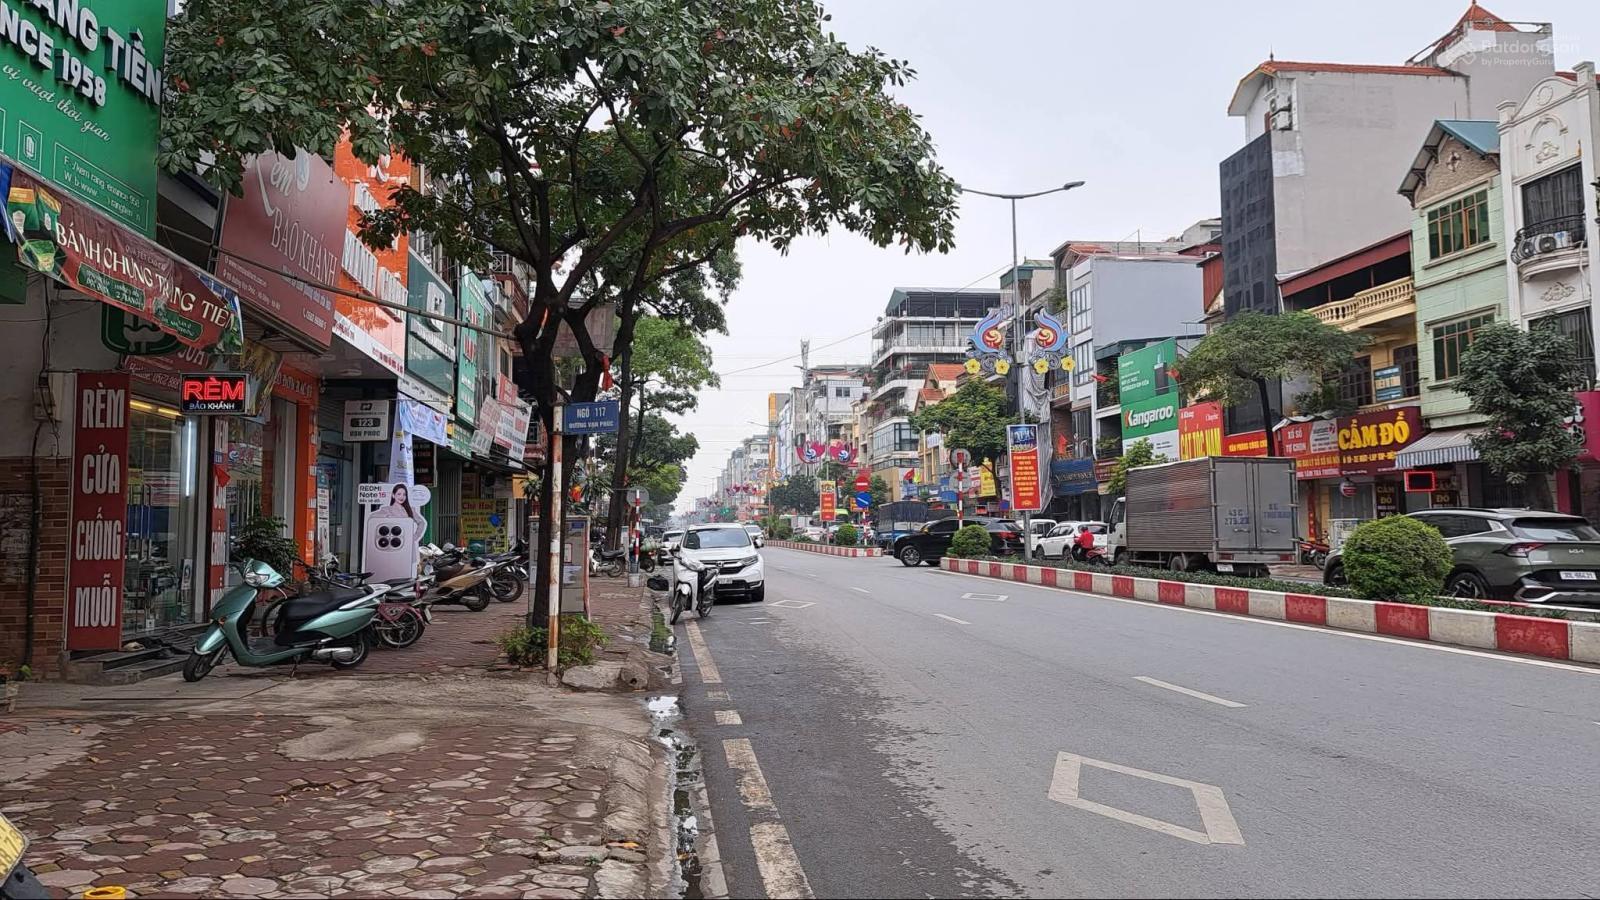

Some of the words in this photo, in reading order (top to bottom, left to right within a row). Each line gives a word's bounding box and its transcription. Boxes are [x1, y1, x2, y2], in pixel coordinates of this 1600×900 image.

[61, 48, 107, 107] 1958
[106, 27, 161, 105] TIỀN
[57, 97, 81, 123] thời
[83, 118, 111, 143] gian
[56, 222, 101, 264] BÁNH
[155, 273, 197, 313] TRNG
[298, 232, 338, 287] KHÁNH
[81, 382, 125, 428] RÈM
[184, 376, 244, 401] RÈM
[207, 402, 235, 410] KHÁNH
[359, 418, 374, 427] 123
[595, 407, 606, 417] 117
[1124, 405, 1174, 429] Kangaroo
[1338, 418, 1379, 451] CẦM
[1378, 410, 1410, 444] ĐỒ
[1205, 427, 1222, 457] NAM
[81, 445, 120, 494] CỬA
[75, 507, 122, 561] CHỐNG
[74, 573, 117, 628] MUỖI
